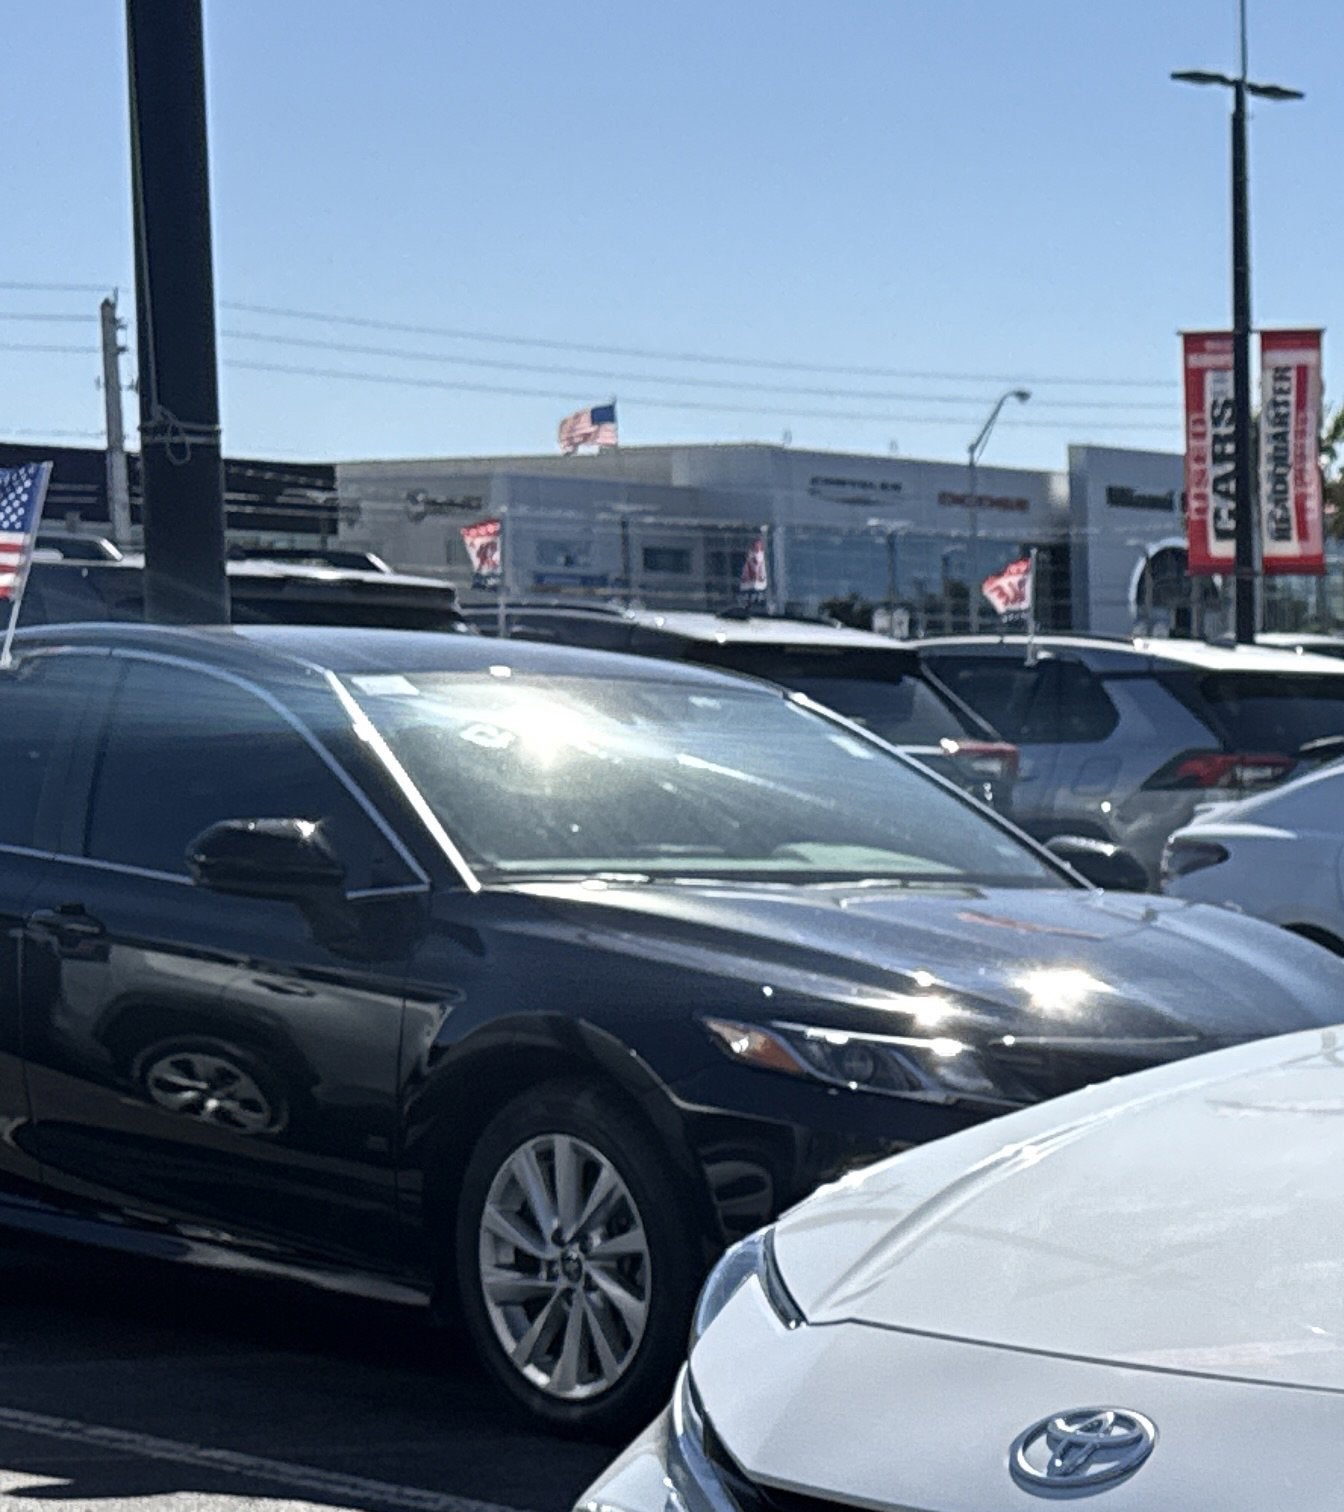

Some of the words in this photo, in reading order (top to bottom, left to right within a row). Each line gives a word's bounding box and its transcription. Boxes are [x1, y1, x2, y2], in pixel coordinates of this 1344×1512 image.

[1189, 414, 1209, 518] USED
[1211, 398, 1237, 541] CARS
[1272, 365, 1293, 542] HEADQUARTER
